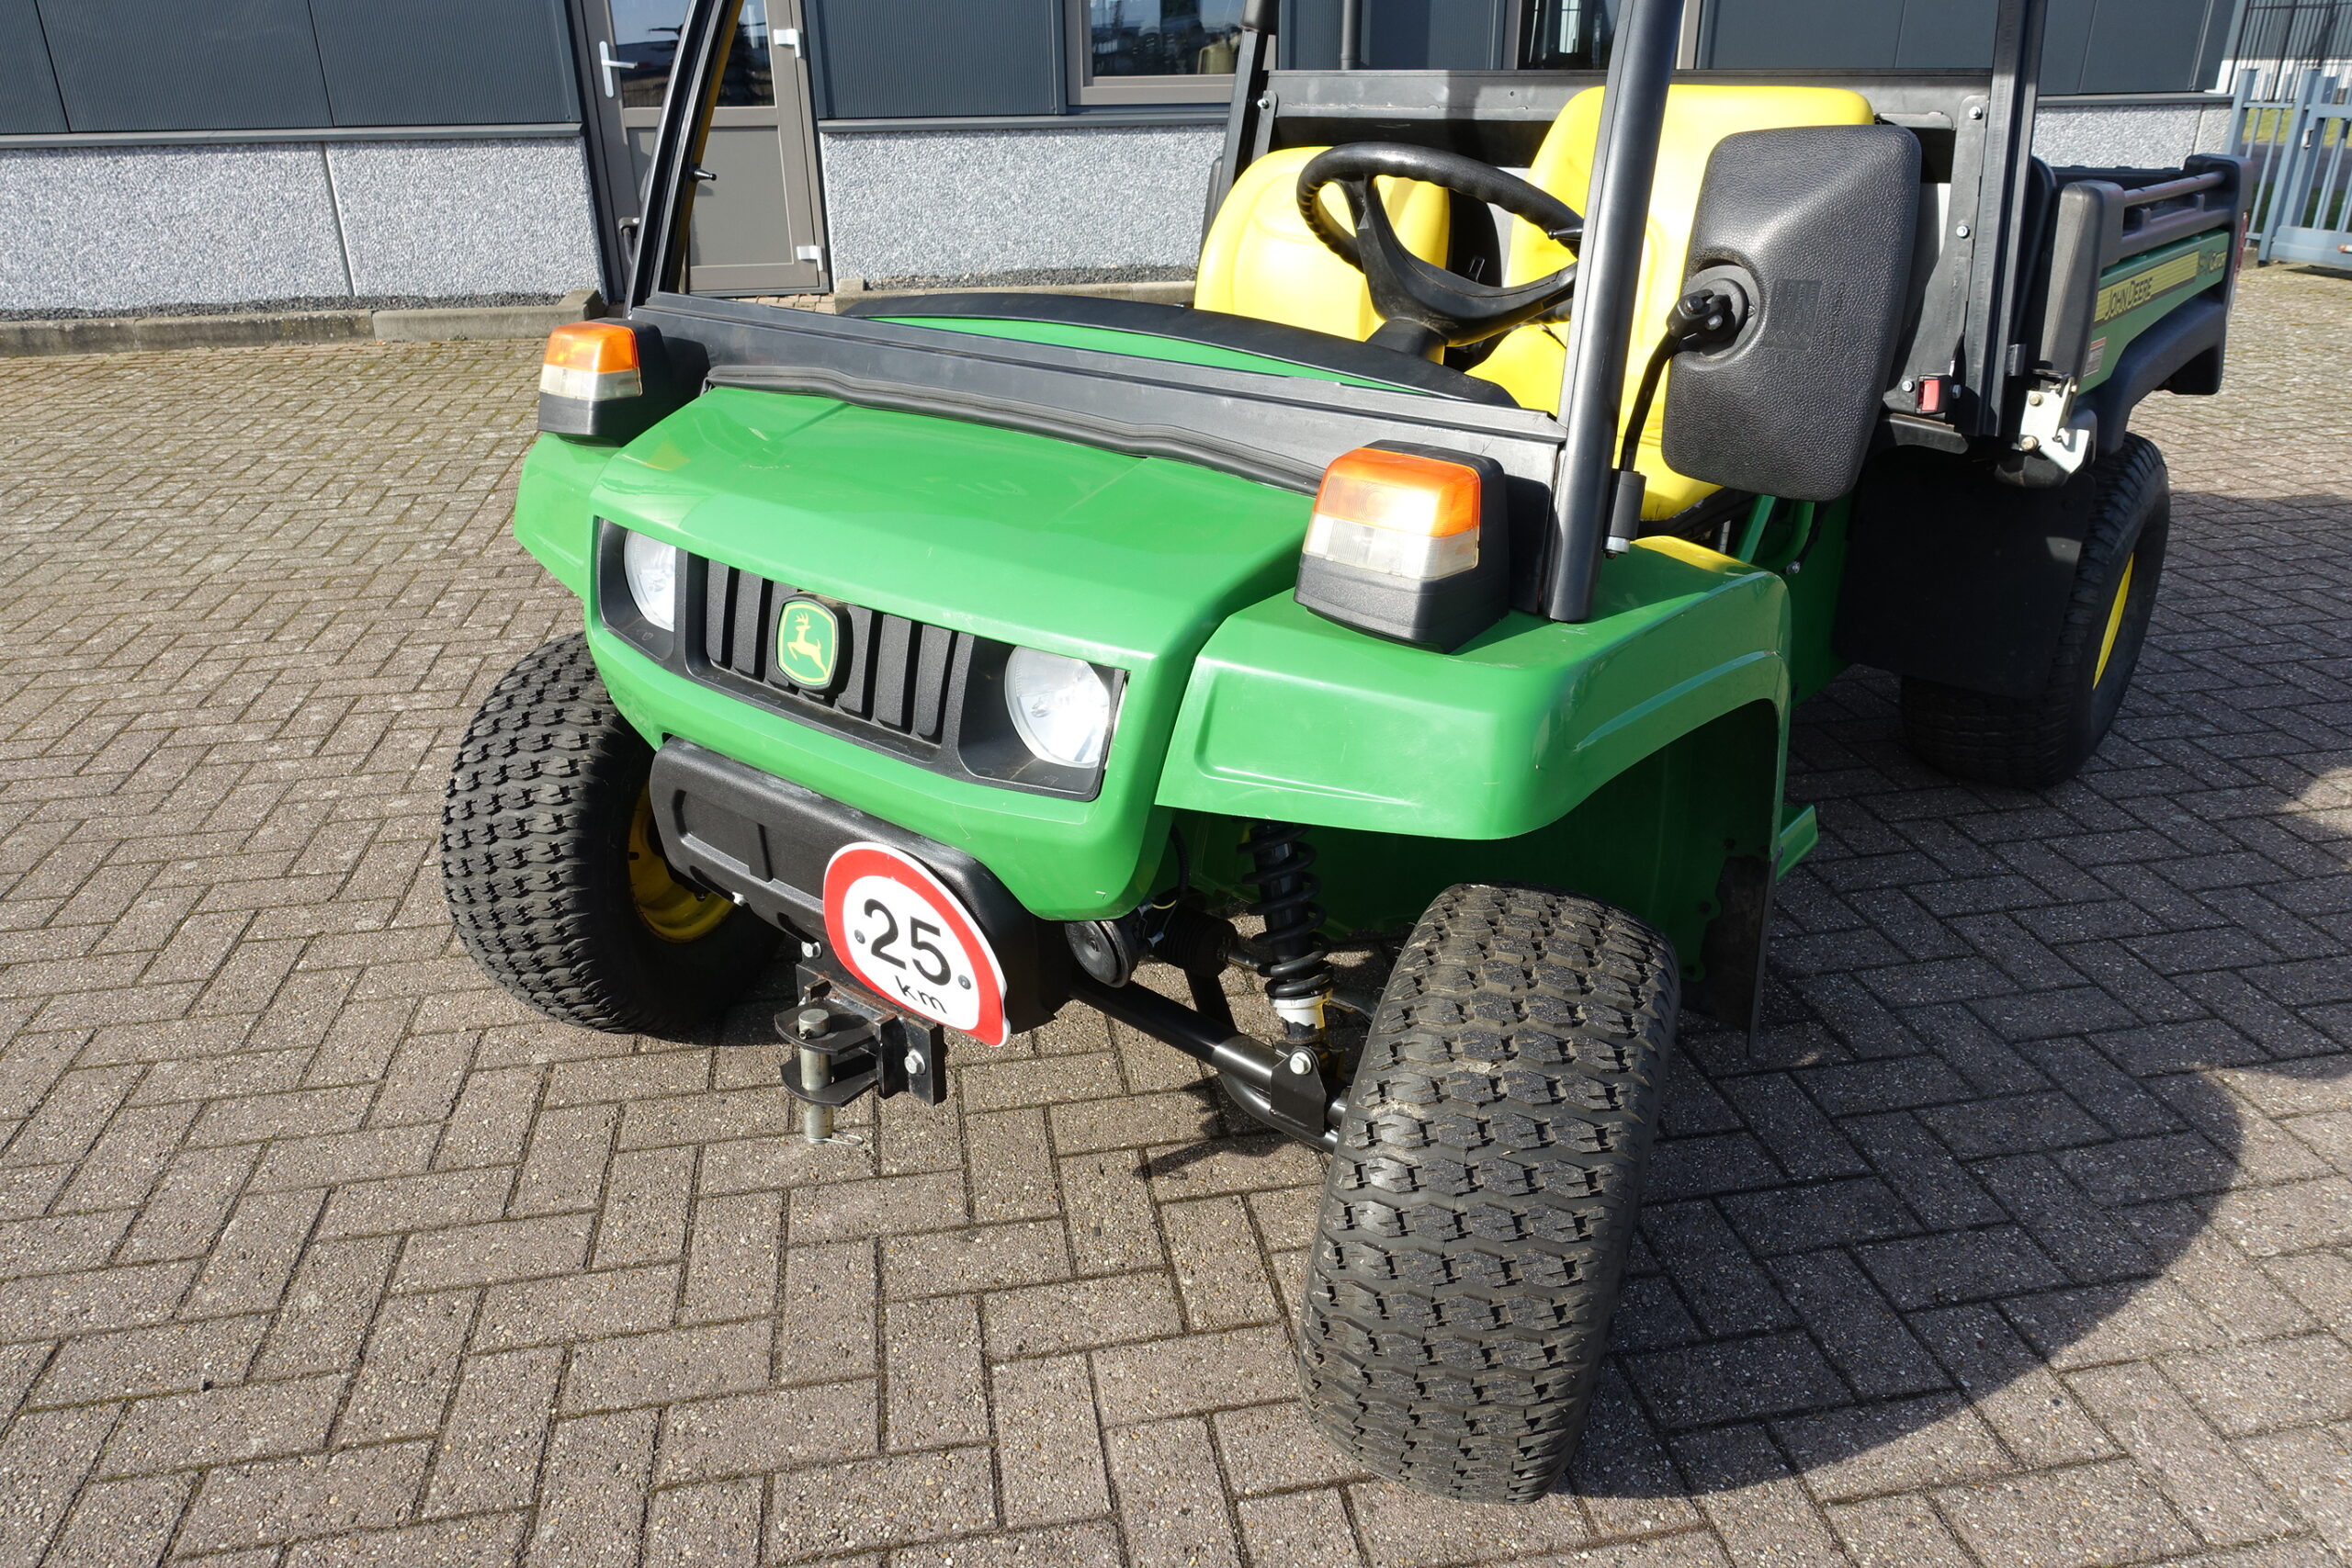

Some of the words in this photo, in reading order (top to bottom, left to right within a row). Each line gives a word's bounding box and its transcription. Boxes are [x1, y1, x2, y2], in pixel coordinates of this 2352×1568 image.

[2106, 288, 2128, 319] JOHN
[2128, 277, 2154, 309] DEERE
[865, 899, 951, 985] 25
[895, 976, 947, 1013] km
